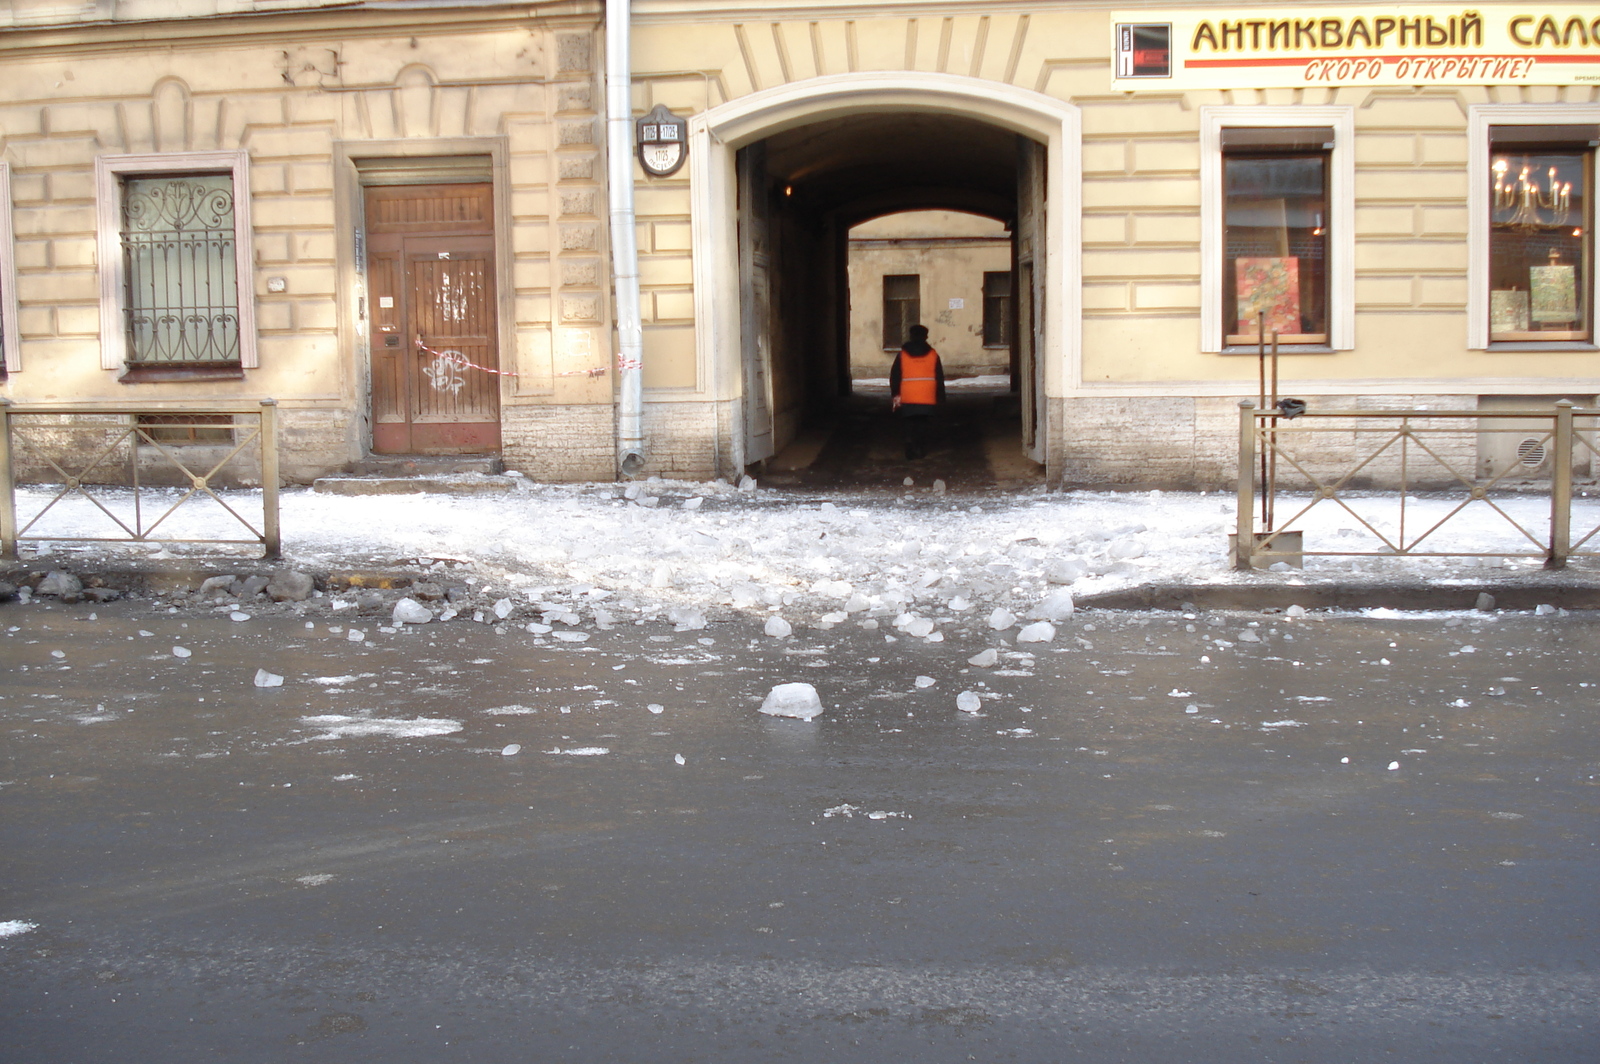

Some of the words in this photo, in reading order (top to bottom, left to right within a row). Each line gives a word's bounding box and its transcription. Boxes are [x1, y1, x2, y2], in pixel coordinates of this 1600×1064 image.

[1193, 13, 1483, 49] АНТИКВАРНЫЙ
[1304, 59, 1381, 80] СКОРО
[1396, 58, 1534, 79] ОТКРЫТИЕ!
